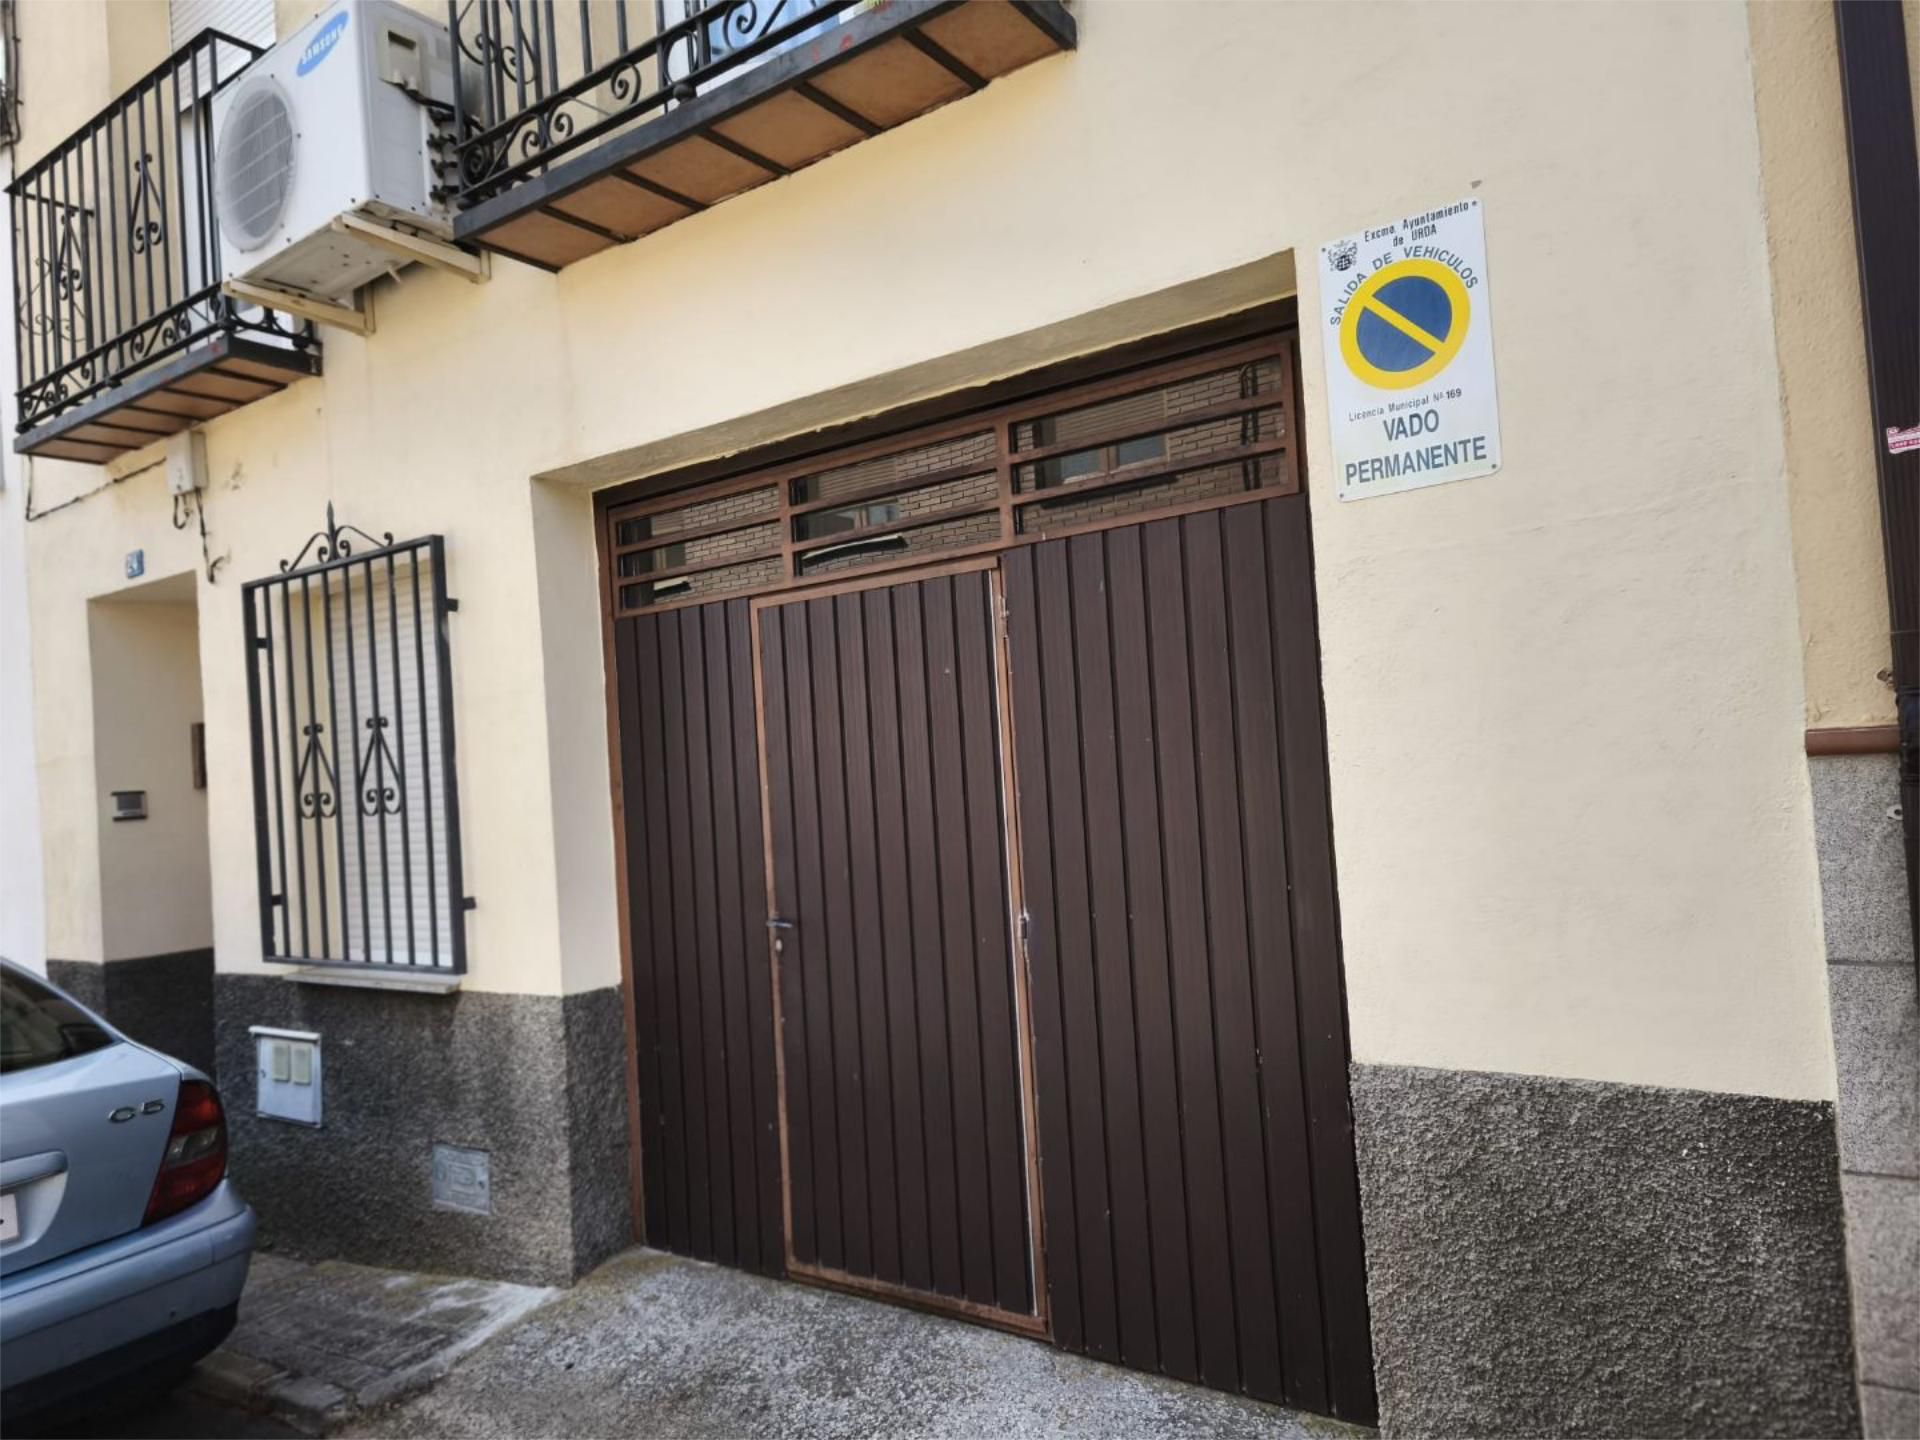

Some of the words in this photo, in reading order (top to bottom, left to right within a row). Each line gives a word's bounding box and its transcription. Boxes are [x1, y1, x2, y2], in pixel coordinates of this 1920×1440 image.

[301, 22, 343, 65] SAMSUNG
[1403, 202, 1469, 230] Ayuntamiento
[1393, 235, 1404, 247] de
[1411, 223, 1437, 241] URDA
[1330, 272, 1367, 326] SALIDA
[1372, 252, 1393, 270] DE
[1404, 245, 1478, 289] VEHICULOS
[1348, 407, 1385, 421] Licencia
[1388, 395, 1429, 413] Municipal
[1446, 388, 1462, 400] 169
[1383, 409, 1439, 441] VADO
[1345, 435, 1488, 486] PERMANENTE
[108, 1099, 165, 1123] C5
